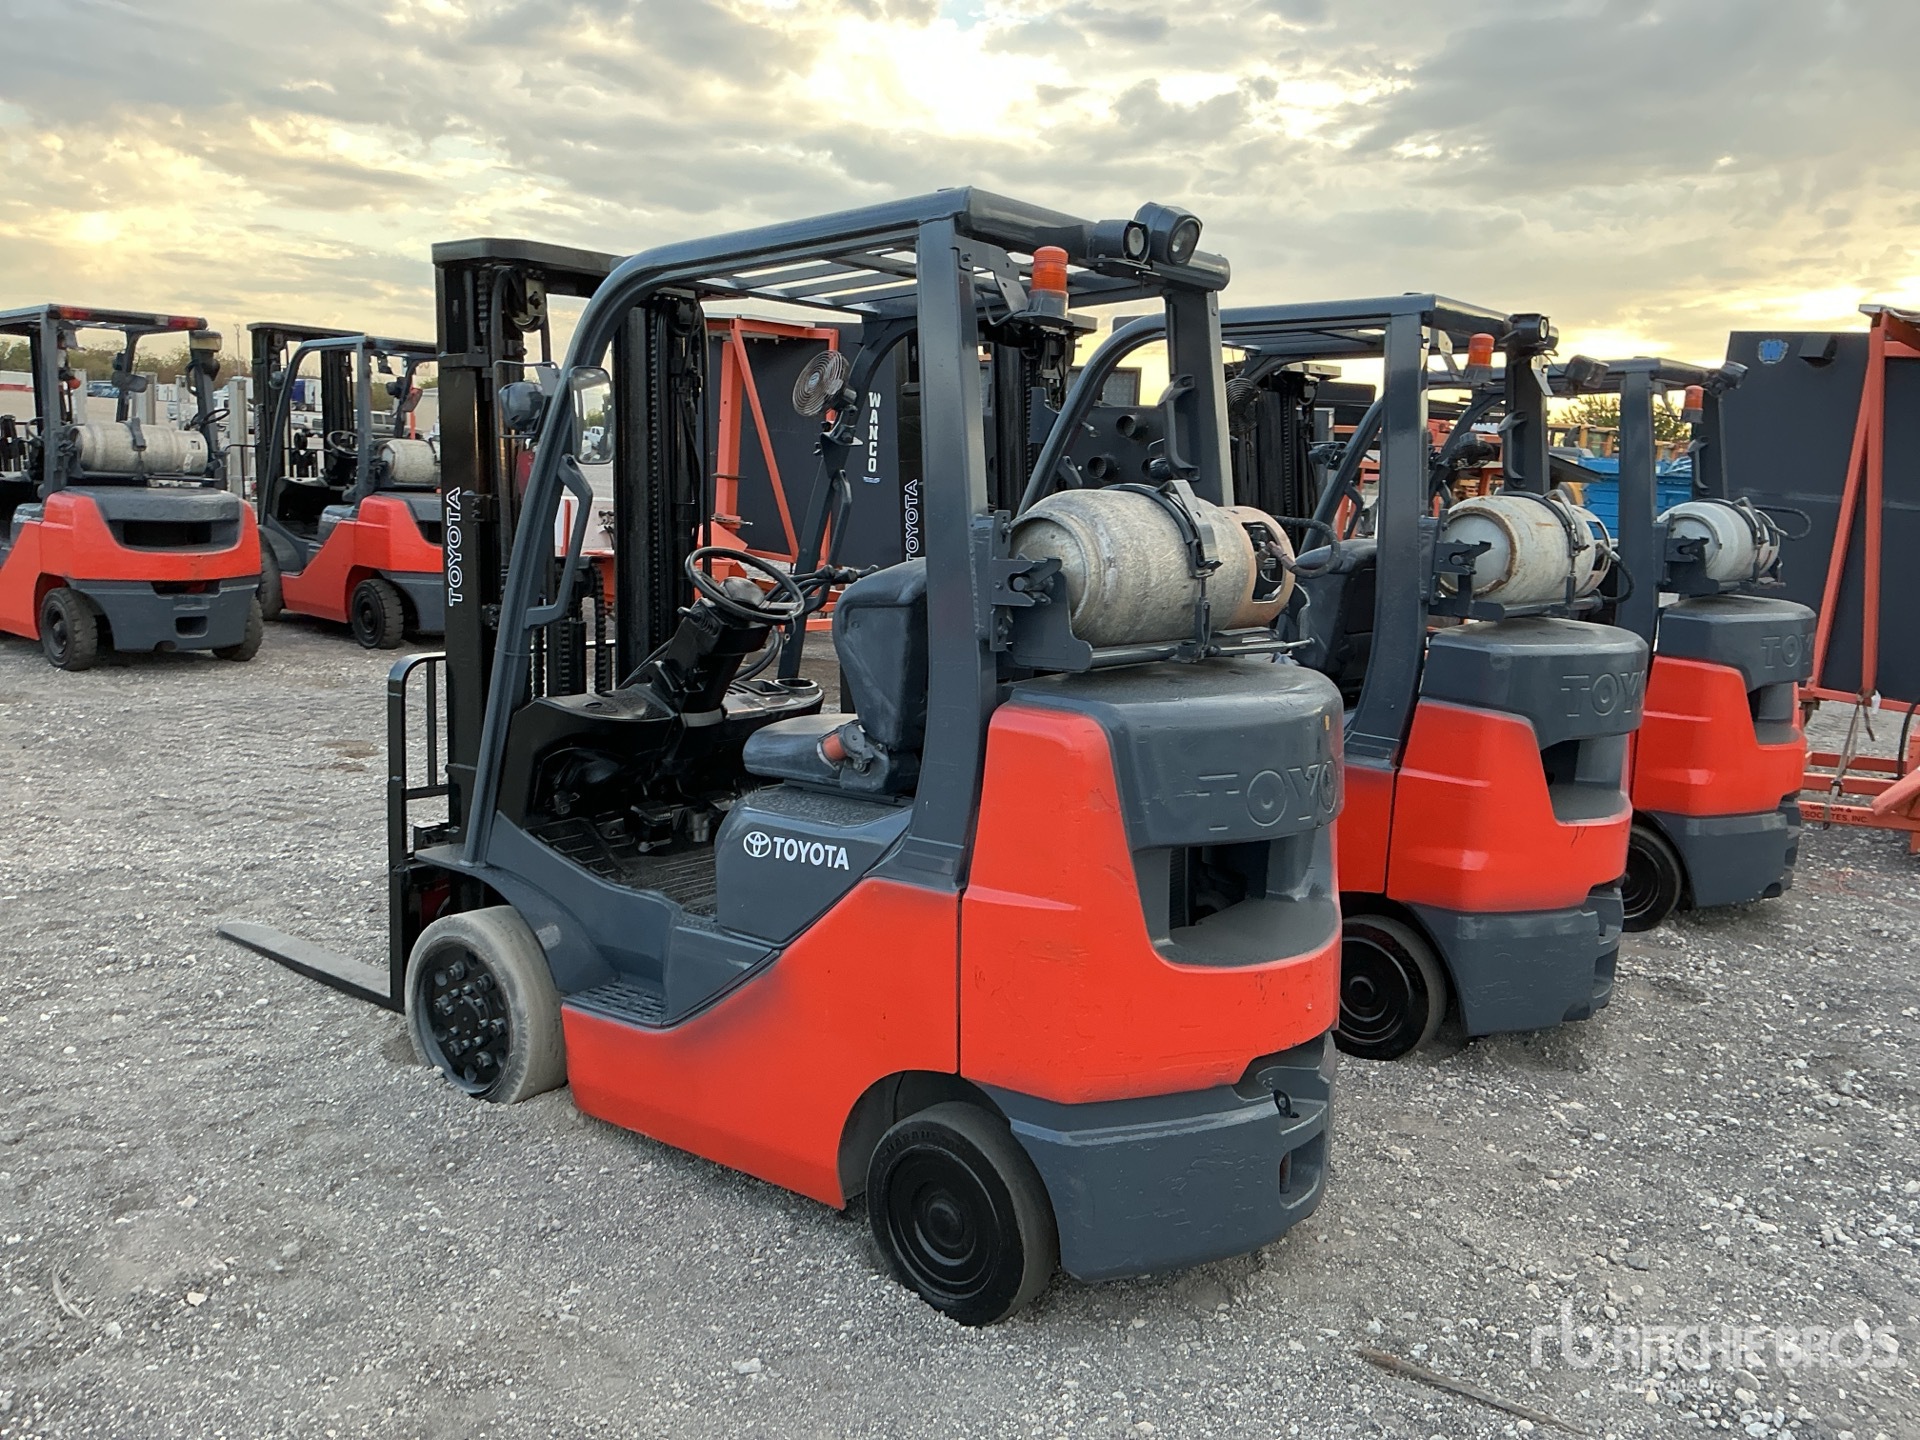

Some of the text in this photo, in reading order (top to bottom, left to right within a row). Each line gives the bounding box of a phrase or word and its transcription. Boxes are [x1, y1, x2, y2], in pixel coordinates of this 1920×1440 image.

[867, 391, 882, 473] WANCO
[446, 487, 463, 607] TOYOTA
[1760, 632, 1814, 670] TOY
[1560, 669, 1645, 718] TOY
[1195, 758, 1338, 832] TOYO
[773, 836, 851, 871] TOYOTA
